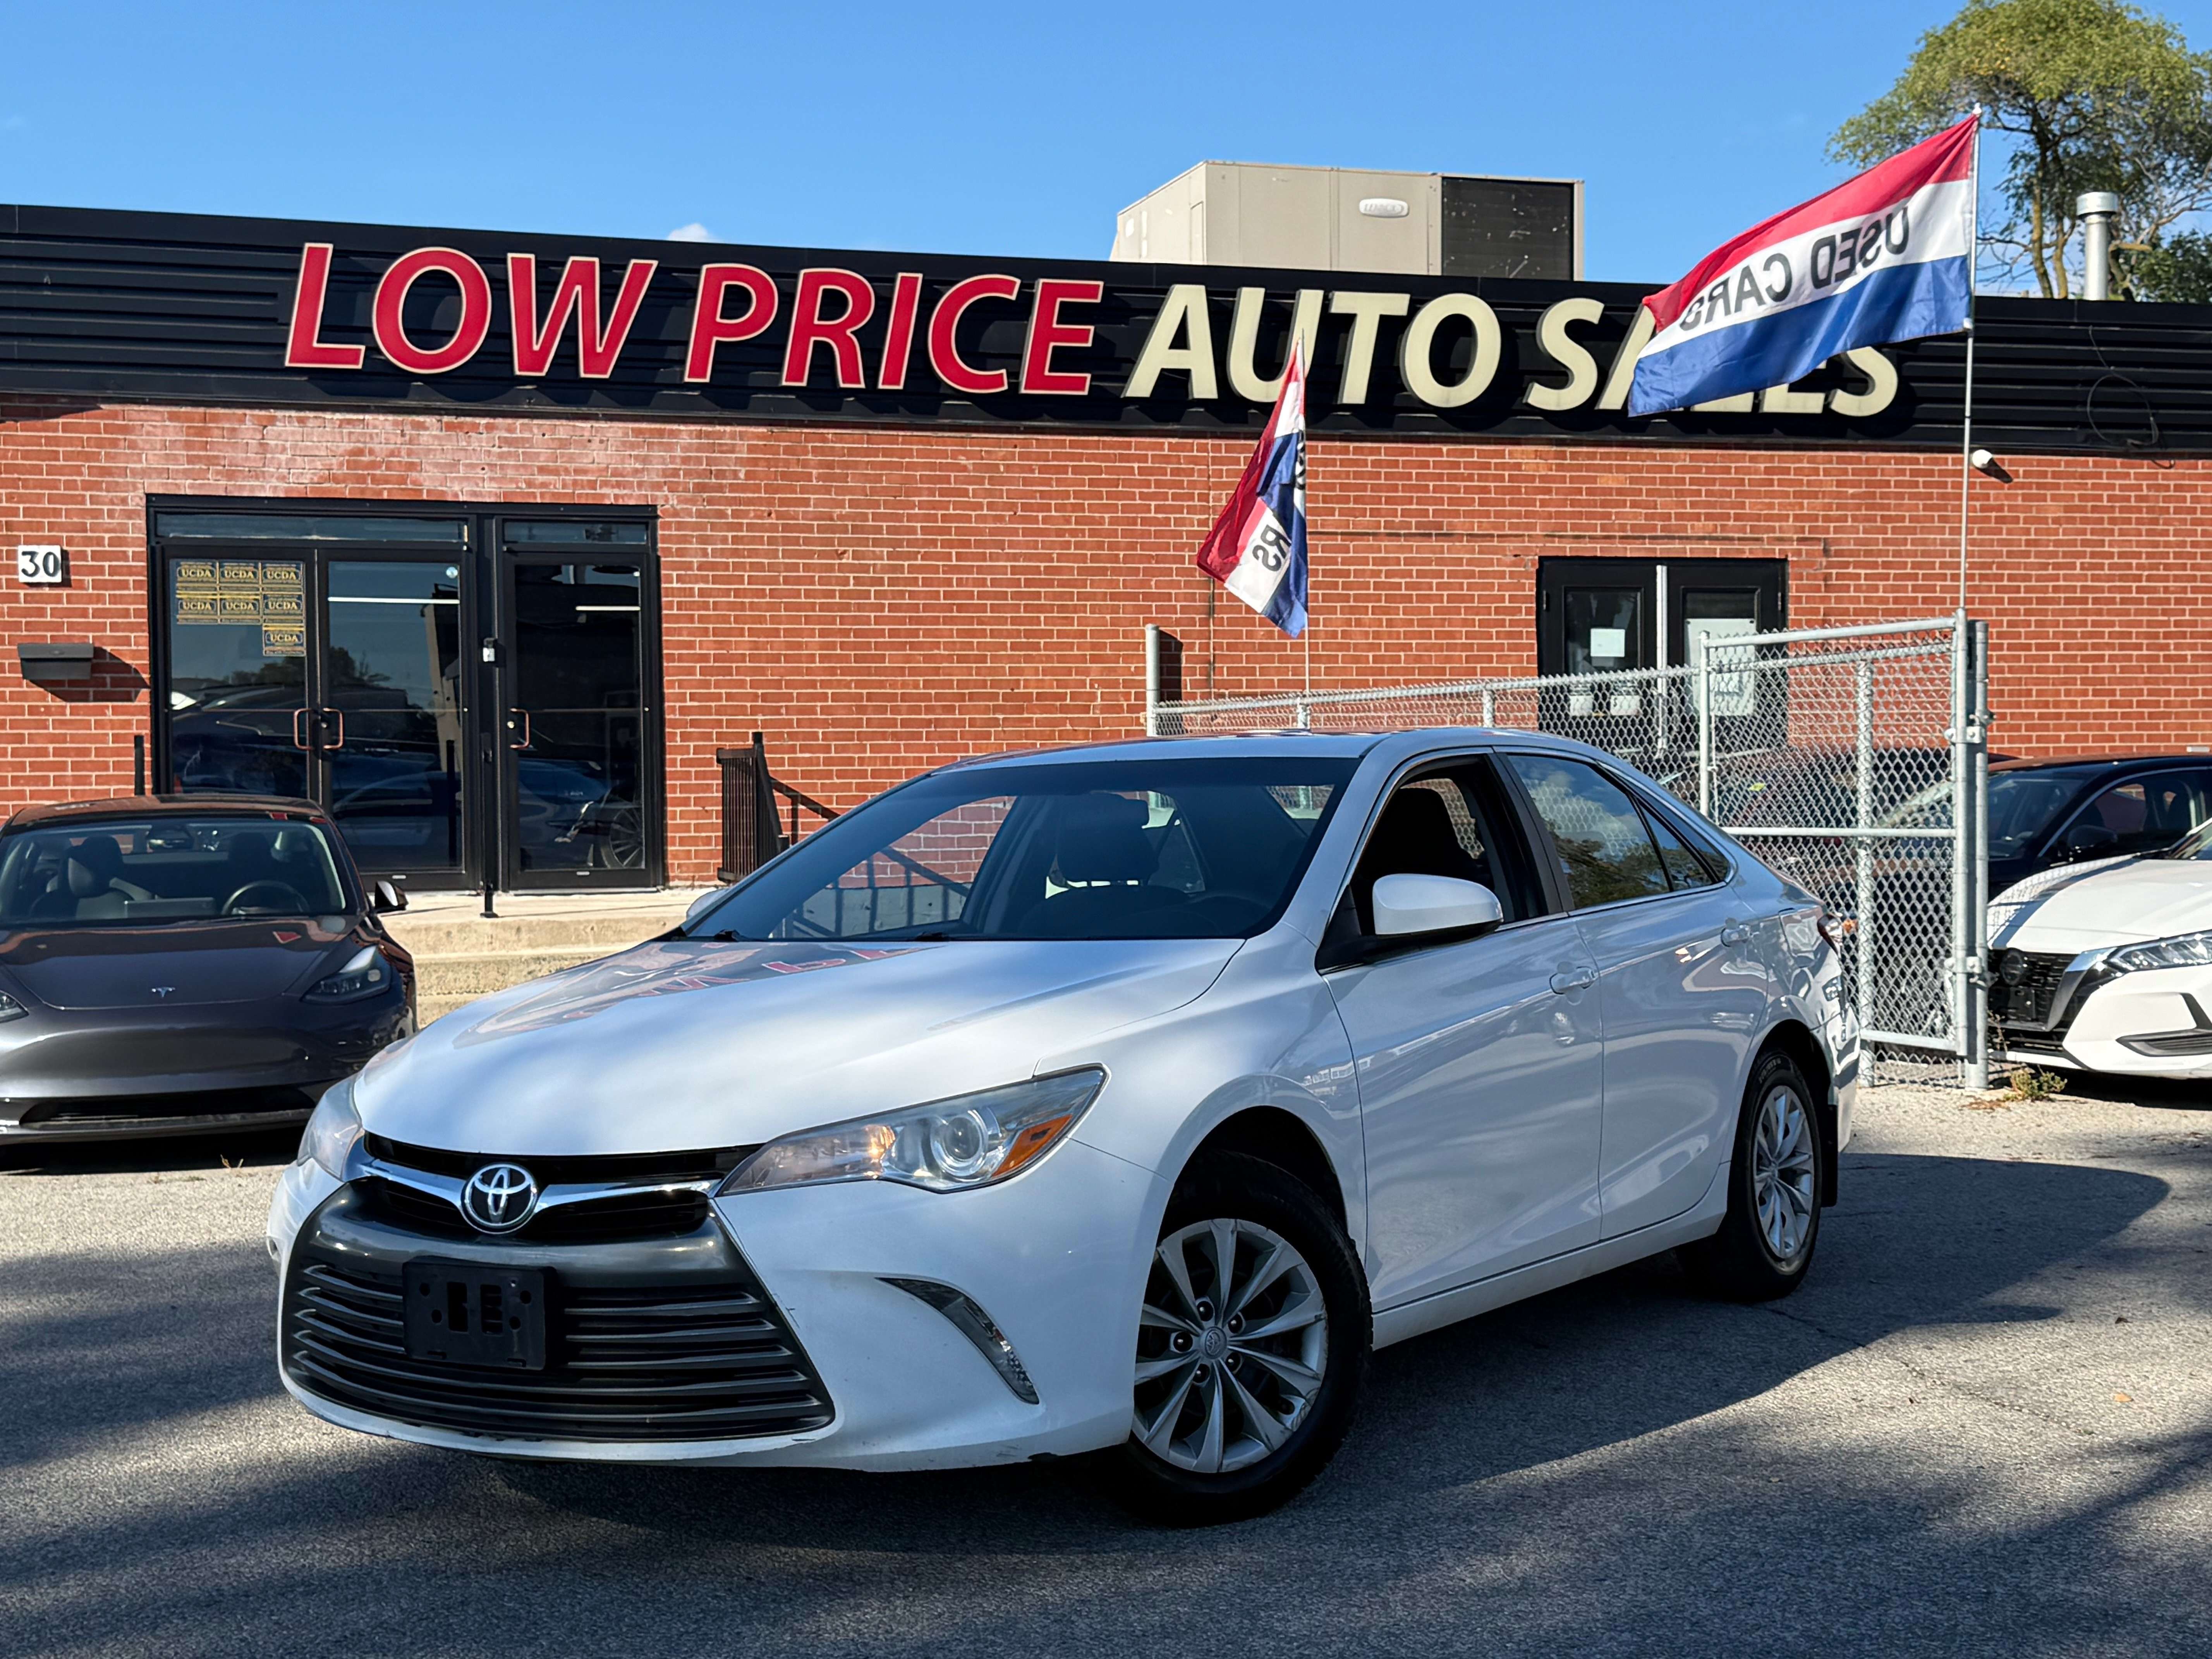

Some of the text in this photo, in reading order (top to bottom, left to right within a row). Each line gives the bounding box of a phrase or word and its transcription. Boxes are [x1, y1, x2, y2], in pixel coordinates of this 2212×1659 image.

[285, 242, 658, 378] LOW
[684, 263, 1104, 395] PRICE
[1122, 284, 1501, 407] AUTO
[21, 551, 60, 577] 30
[182, 569, 211, 578] UCDA
[225, 570, 254, 579] UCDA
[267, 571, 296, 580] UCDA
[183, 601, 212, 610] UCDA
[225, 602, 254, 611] UCDA
[268, 601, 298, 610] UCDA
[270, 634, 298, 642] UCDA
